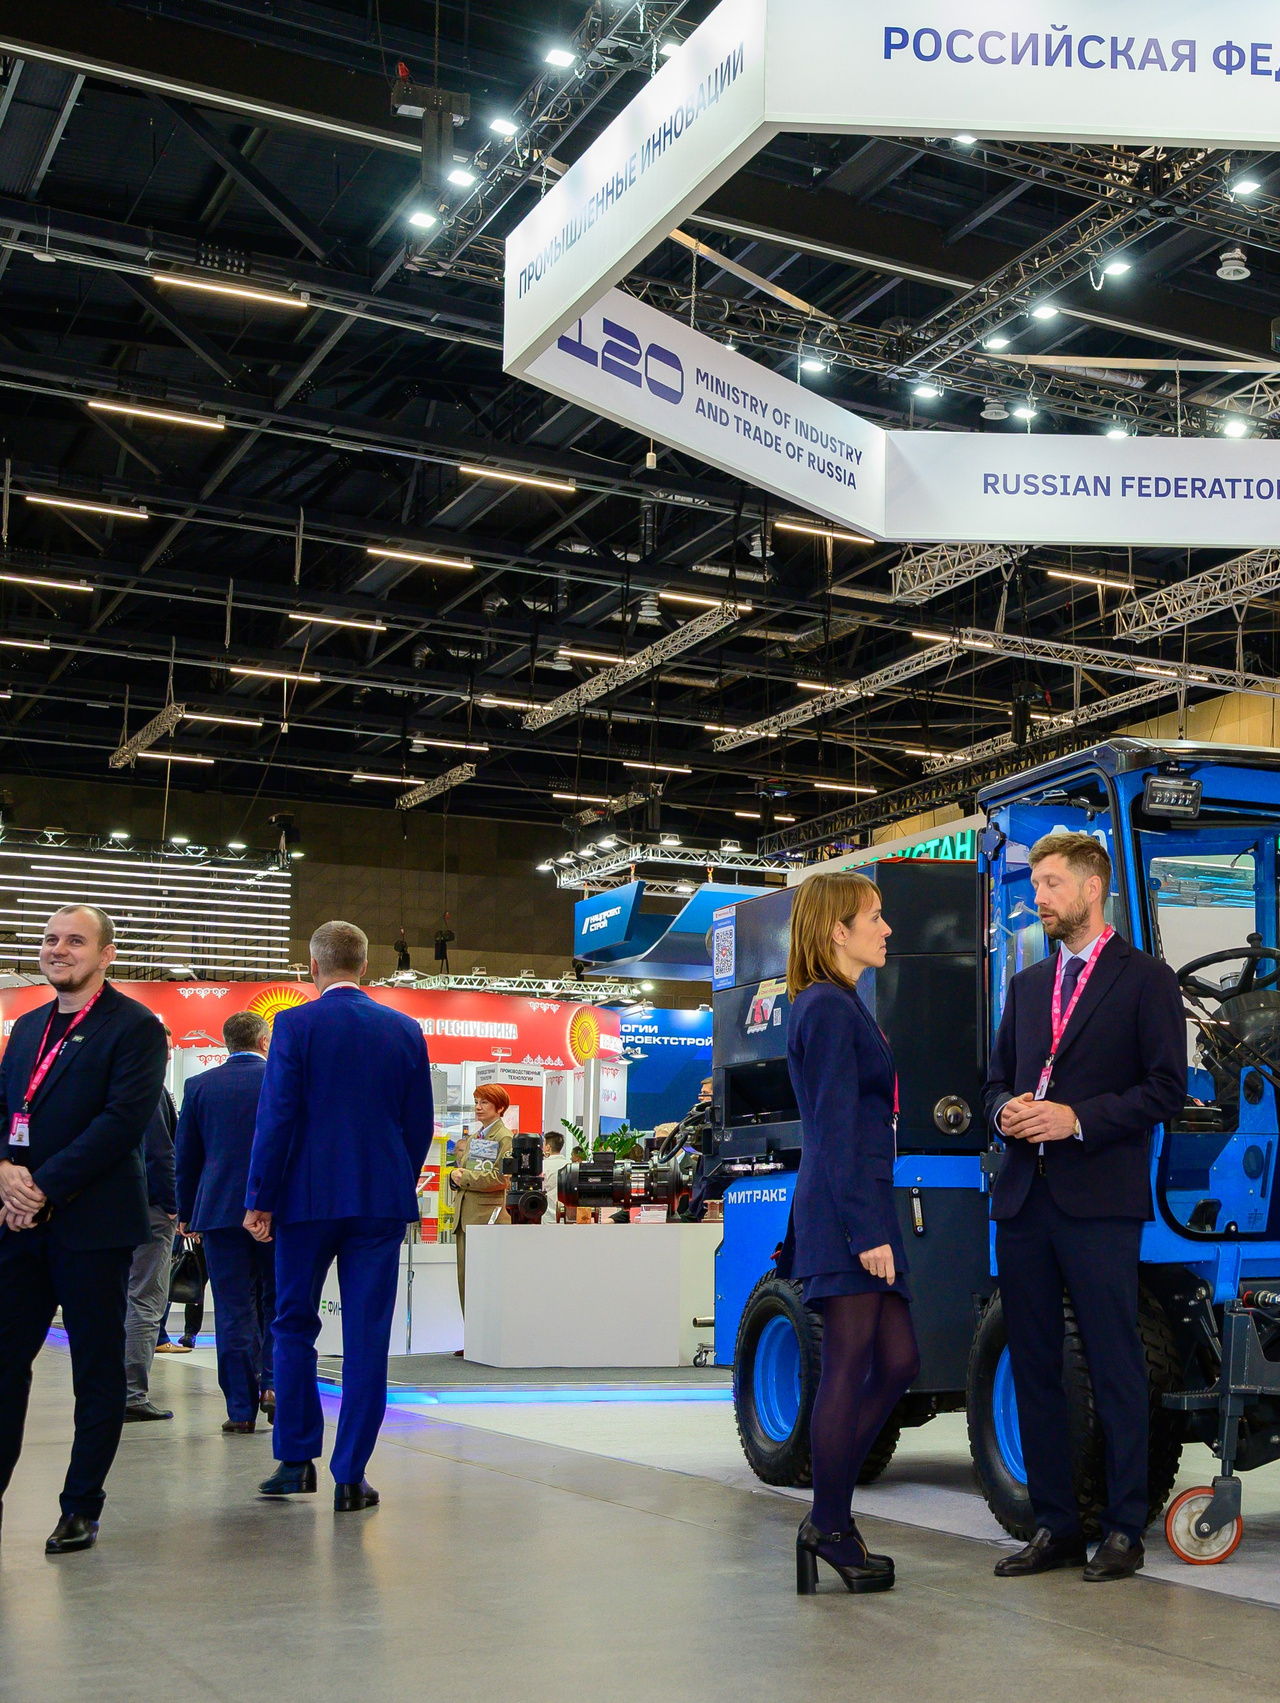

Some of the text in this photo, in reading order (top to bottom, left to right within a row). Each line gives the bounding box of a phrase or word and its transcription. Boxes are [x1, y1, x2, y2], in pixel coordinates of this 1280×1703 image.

[883, 24, 1197, 73] РОССИЙСКАЯ
[518, 41, 745, 299] ПРОМЫШЛЕННЫЕ ИННОВАЦИИ
[695, 367, 863, 466] MINISTRY OF INDUSTRY
[695, 397, 857, 491] AND TRADE OF RUSSIA
[982, 472, 1112, 498] RUSSIAN
[438, 1020, 518, 1040] РЕСПУБЛИКА
[727, 1188, 787, 1205] МИТРАКС
